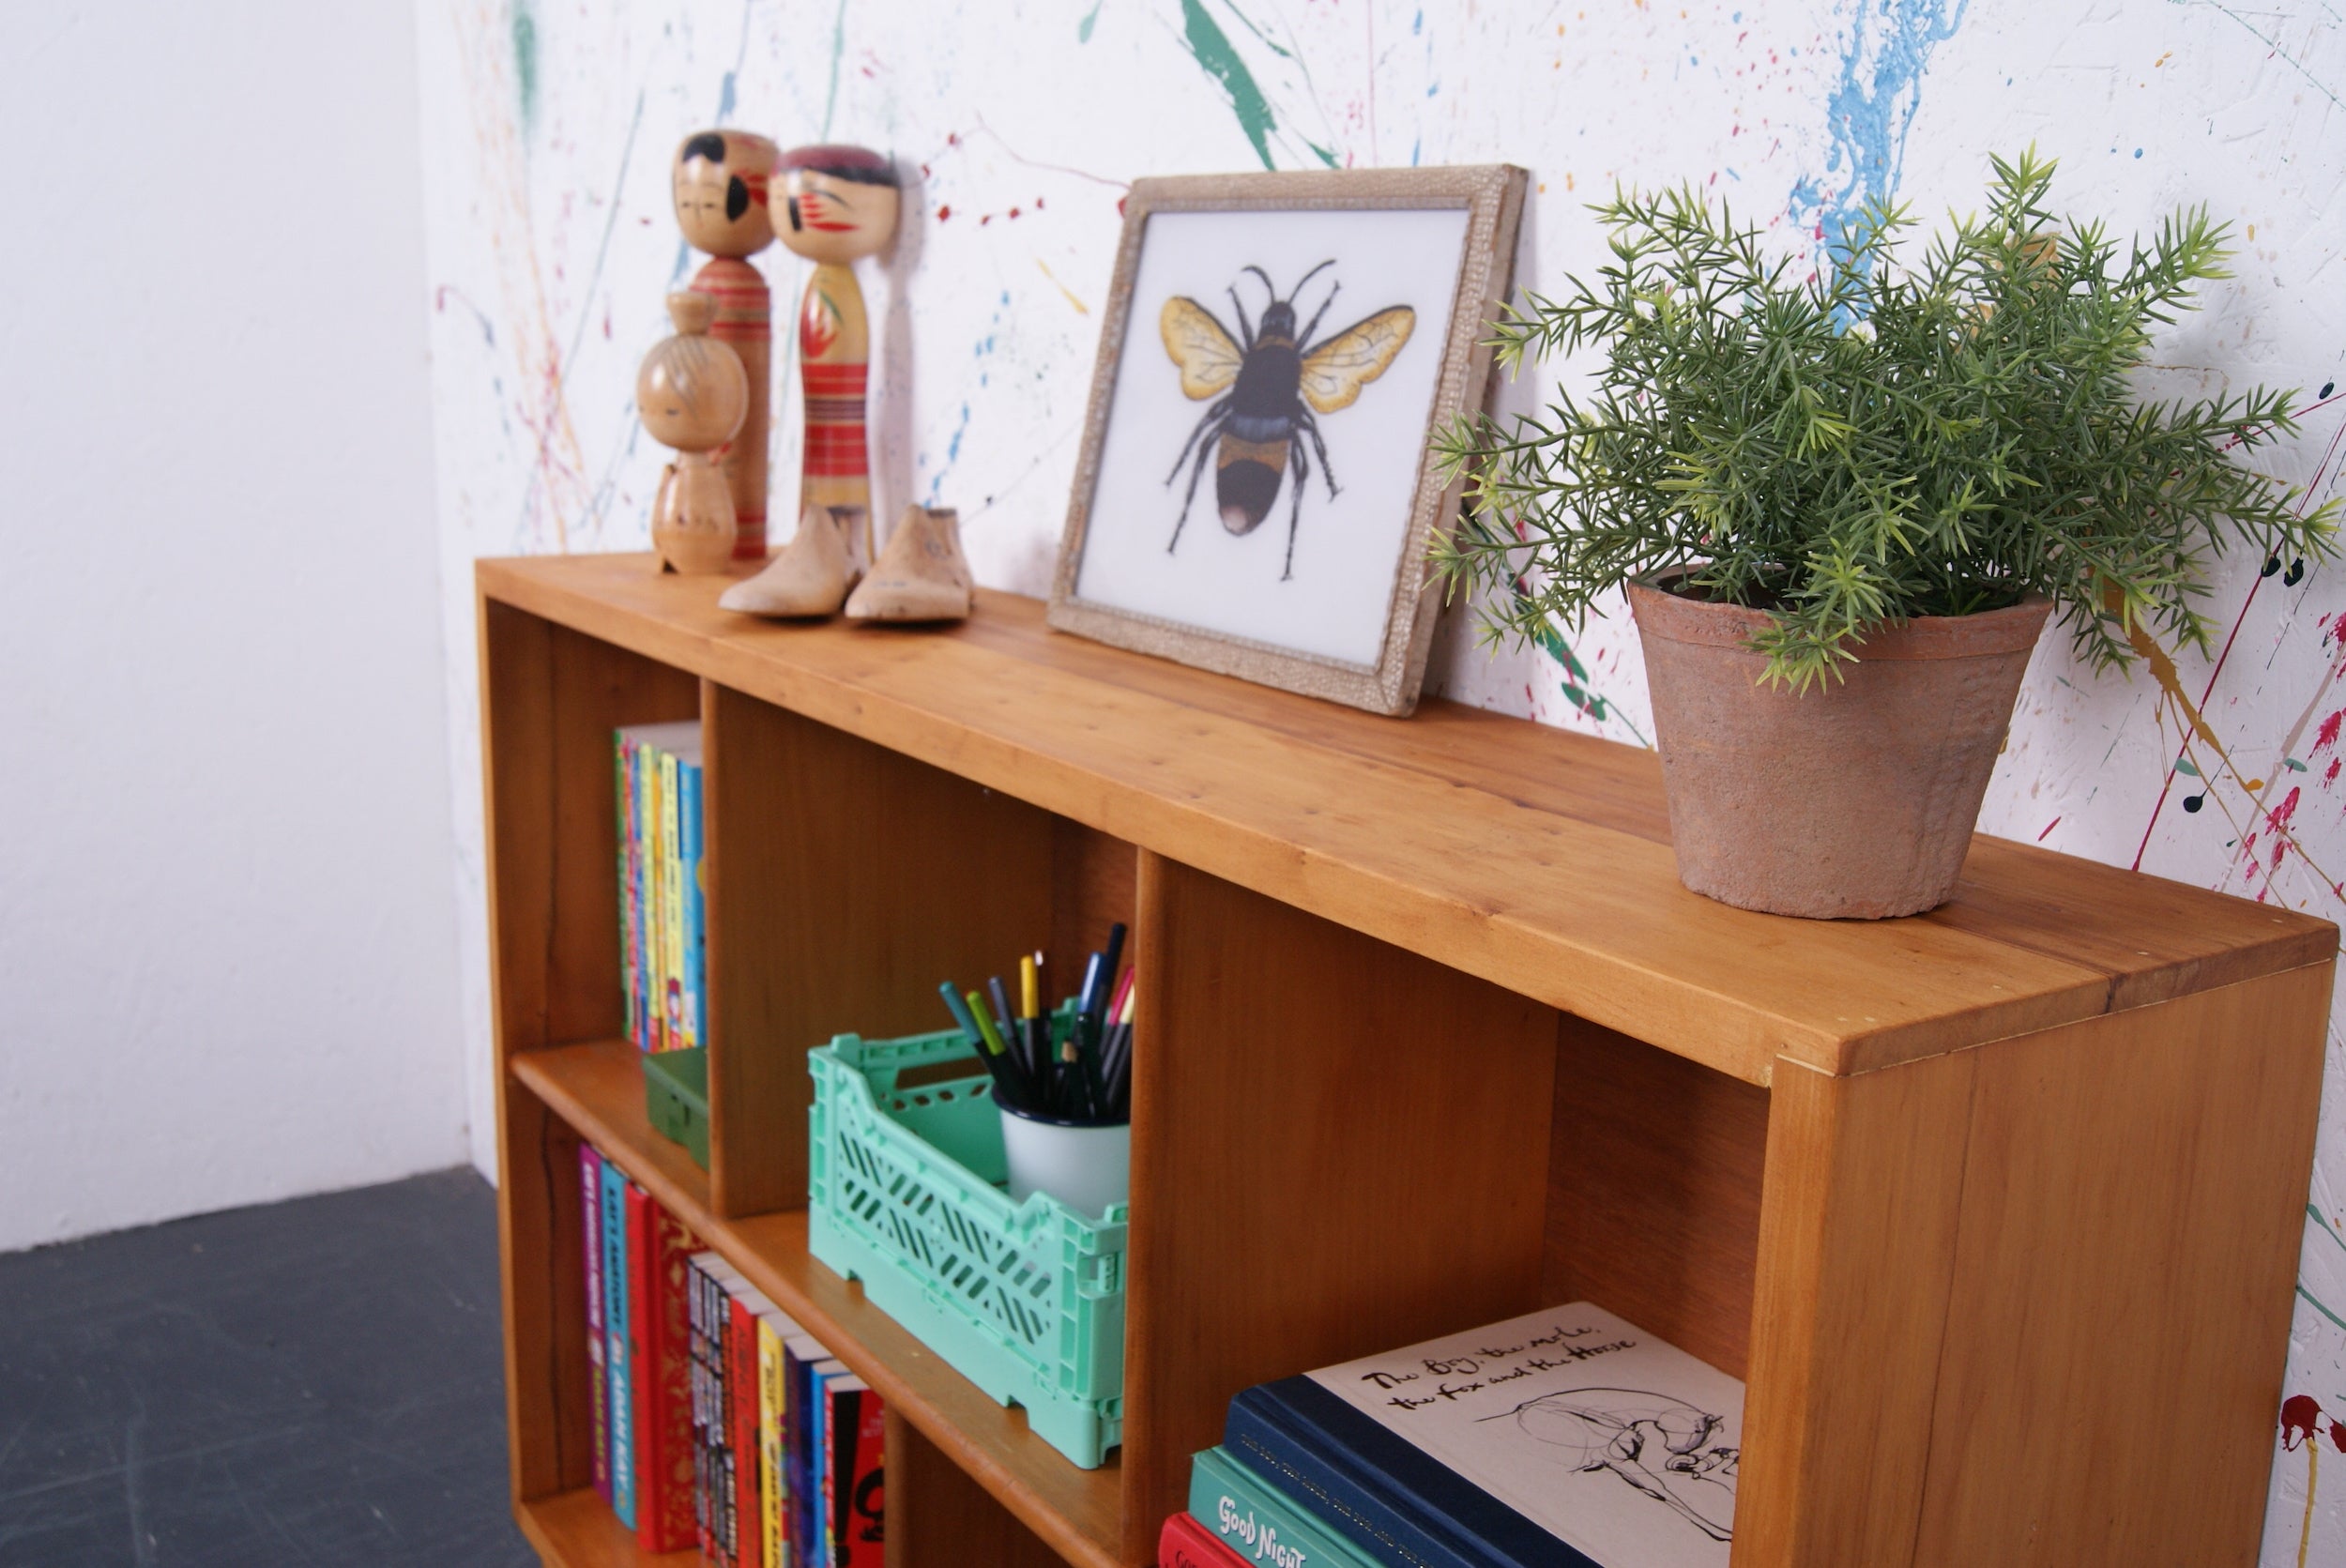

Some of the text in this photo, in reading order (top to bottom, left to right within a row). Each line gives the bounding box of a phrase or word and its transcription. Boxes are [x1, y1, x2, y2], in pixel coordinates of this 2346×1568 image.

[1362, 1372, 1420, 1390] The
[1474, 1345, 1526, 1358] the
[1387, 1396, 1436, 1410] the
[1436, 1382, 1485, 1400] fox
[1488, 1366, 1534, 1384] and
